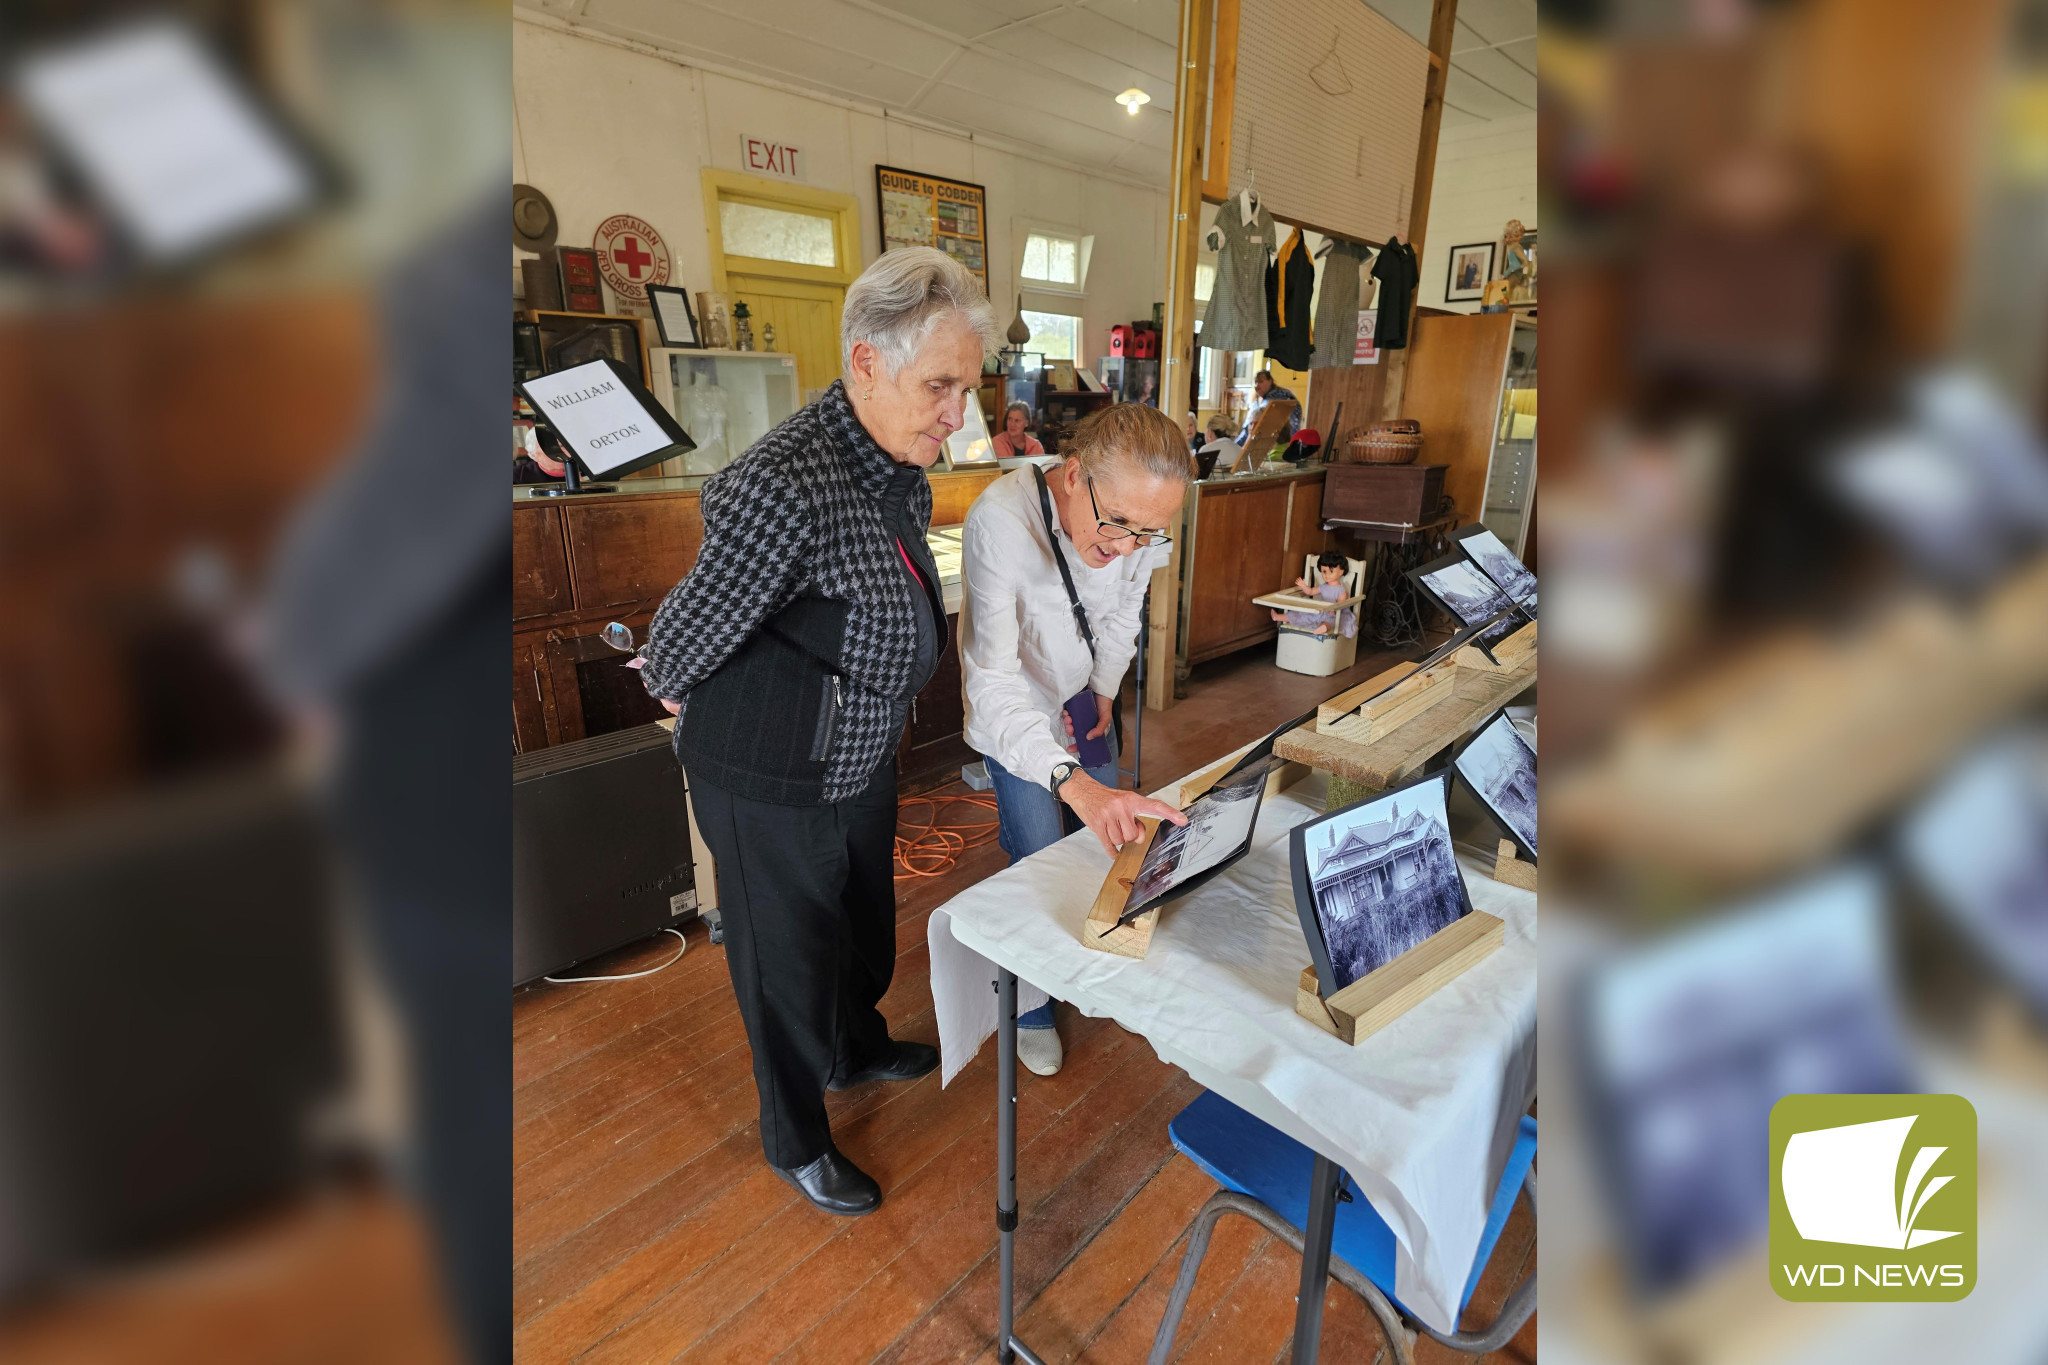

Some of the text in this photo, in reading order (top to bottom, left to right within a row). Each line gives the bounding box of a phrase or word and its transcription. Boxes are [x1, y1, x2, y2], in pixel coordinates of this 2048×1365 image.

[748, 139, 799, 176] EXIT
[881, 174, 982, 203] GUIDE to COBDEN
[601, 219, 659, 246] AUSTRALIAN
[597, 250, 611, 273] RED
[608, 272, 642, 296] CROSS
[547, 381, 616, 410] WILLIAM
[589, 423, 641, 450] ORTON
